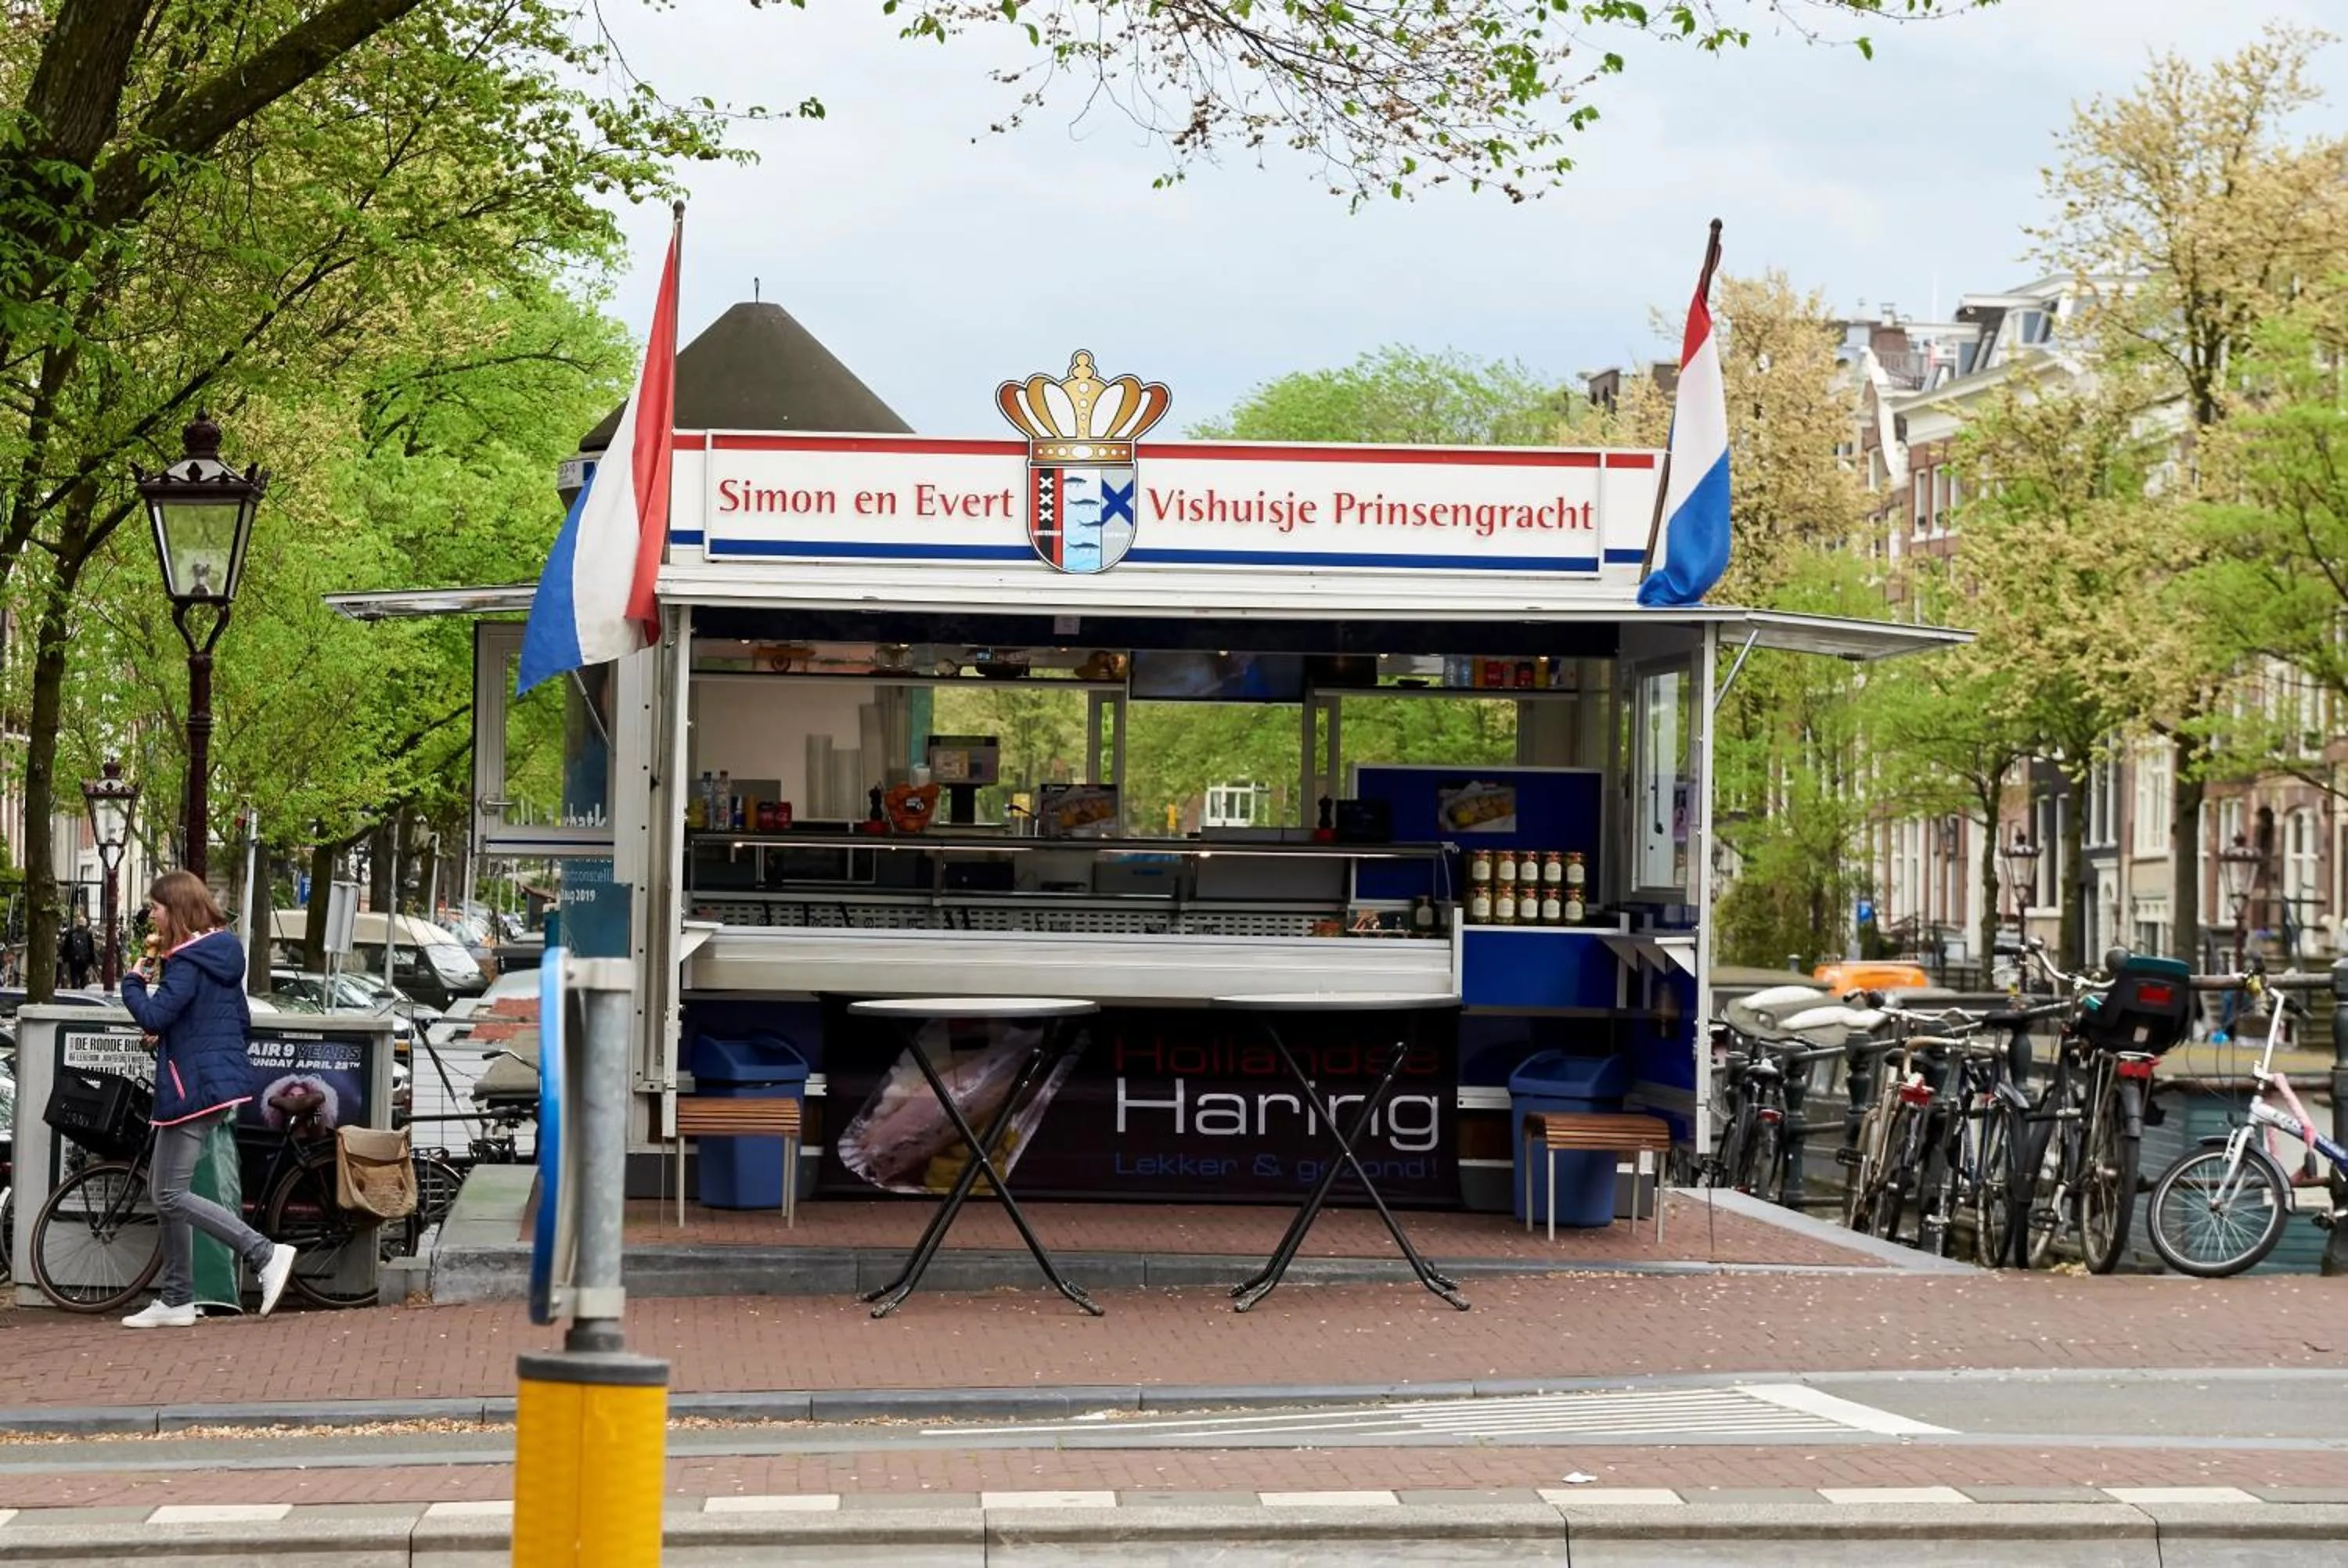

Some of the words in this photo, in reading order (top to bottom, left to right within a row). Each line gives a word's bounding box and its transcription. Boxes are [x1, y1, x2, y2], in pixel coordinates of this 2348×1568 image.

[719, 480, 836, 513] Simon
[854, 493, 896, 514] en
[916, 484, 1014, 517] Evert
[1147, 487, 1317, 533] Vishuisje
[1334, 492, 1594, 537] Prinsengracht
[575, 889, 596, 902] 2019
[75, 1037, 88, 1051] DE
[90, 1038, 122, 1052] ROODE
[247, 1041, 280, 1056] AIR
[297, 1045, 362, 1060] YEARS
[1114, 1034, 1441, 1076] Hollandse
[296, 1059, 332, 1070] APRIL
[1116, 1077, 1439, 1152] Haring
[1115, 1152, 1238, 1177] Lekker
[1252, 1153, 1283, 1177] &
